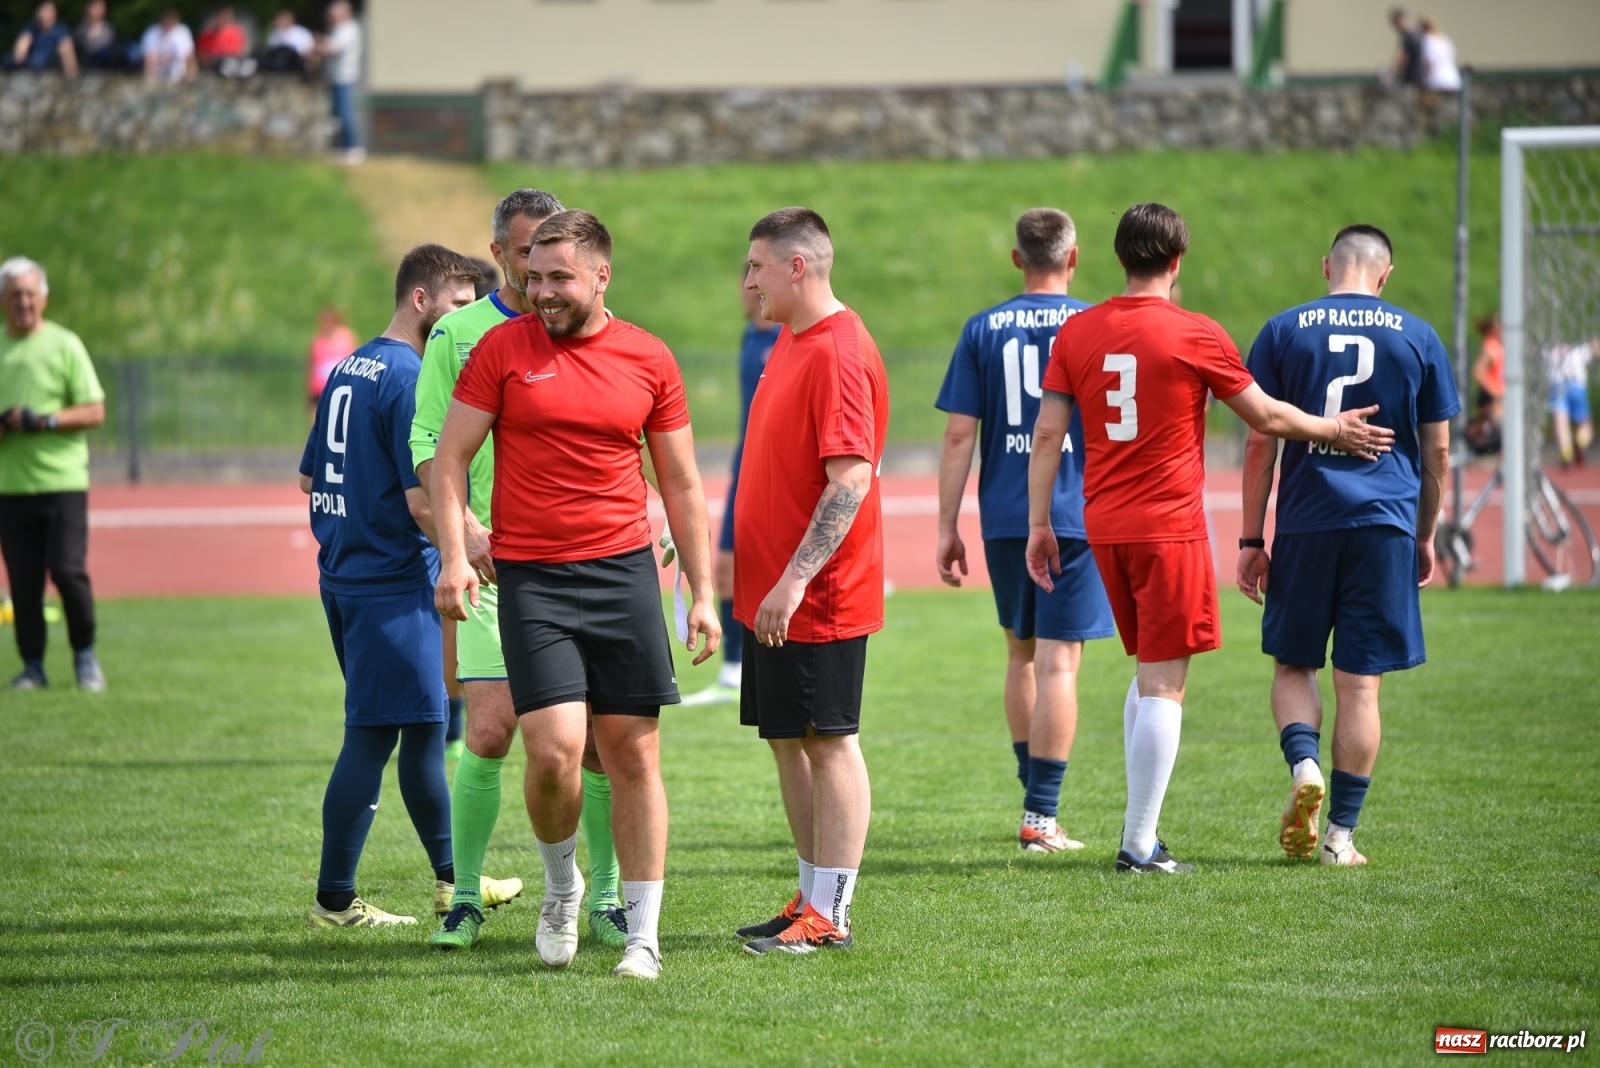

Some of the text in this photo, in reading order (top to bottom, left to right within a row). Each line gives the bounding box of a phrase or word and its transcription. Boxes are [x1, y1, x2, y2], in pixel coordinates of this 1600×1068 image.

[989, 310, 1014, 330] KPP
[1299, 306, 1403, 331] KPP RACIBÓRZ
[1102, 354, 1138, 441] 3
[1324, 334, 1375, 424] 2
[325, 385, 352, 484] 9
[1006, 433, 1073, 454] POLA
